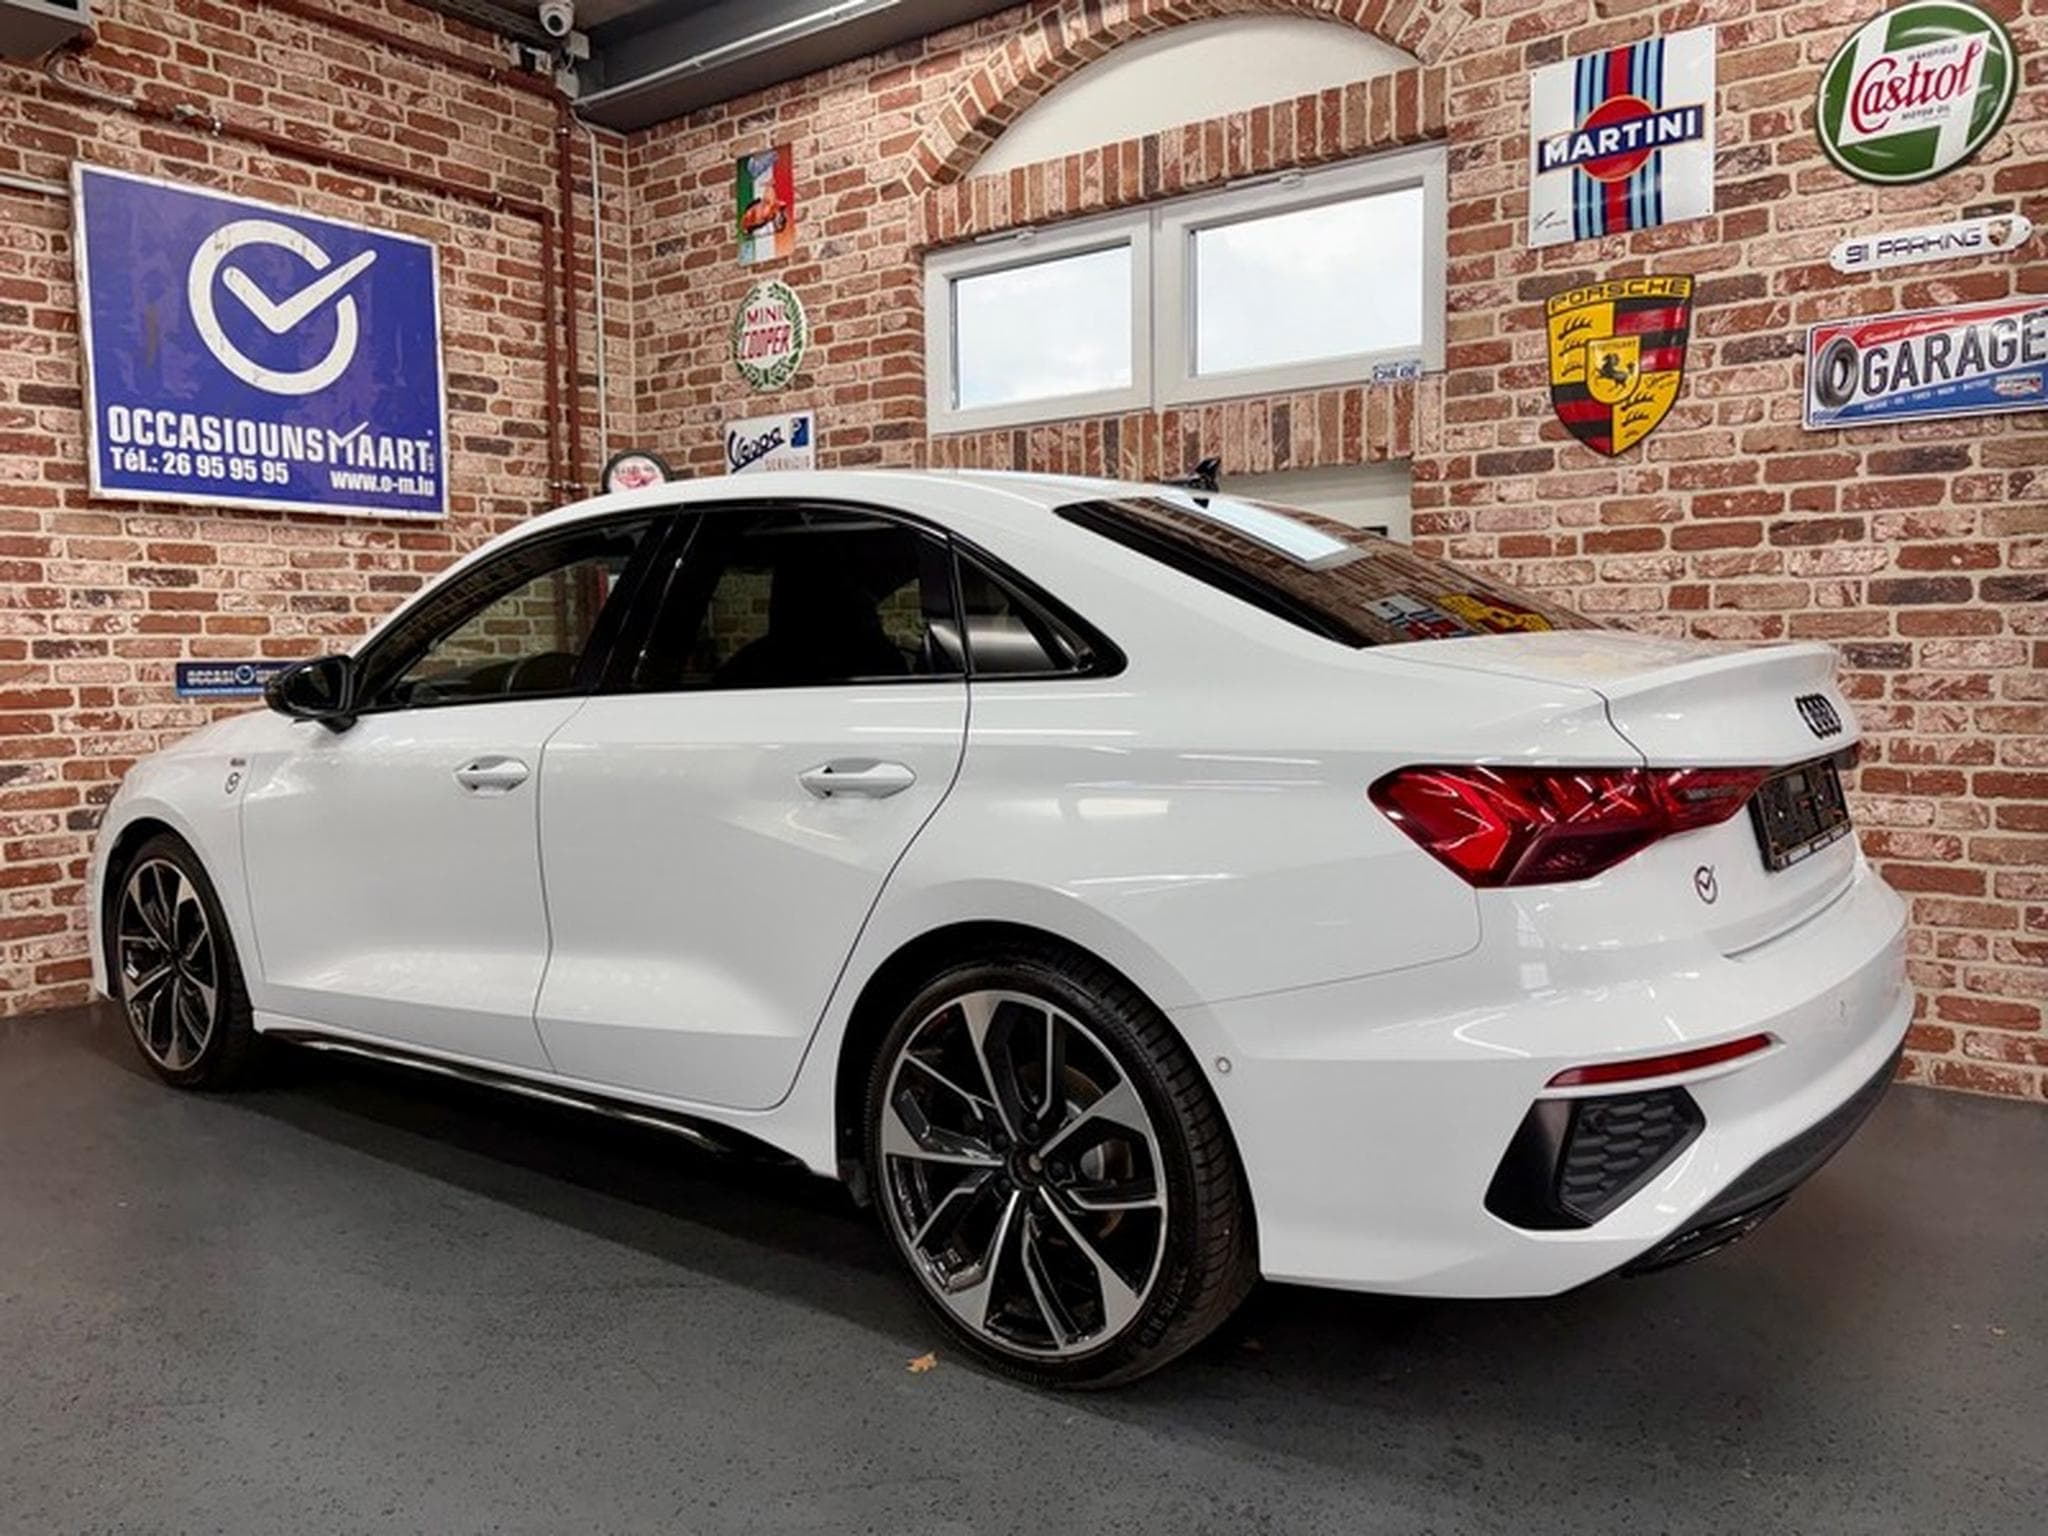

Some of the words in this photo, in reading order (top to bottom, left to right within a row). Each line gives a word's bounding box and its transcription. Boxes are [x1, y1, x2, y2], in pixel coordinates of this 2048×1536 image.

[1851, 40, 1983, 134] Castrol
[1544, 109, 1695, 168] MARTINI
[1876, 227, 1982, 260] PARKING
[1551, 278, 1686, 310] PORSCHE
[747, 304, 785, 326] MINI
[740, 325, 791, 360] COOPER
[1862, 310, 2048, 398] GARAGE
[107, 405, 431, 474] OCCASIOUNSMAART
[728, 427, 785, 474] Vespa
[163, 451, 191, 476] 26
[197, 455, 225, 479] 95
[230, 458, 257, 482] 95
[262, 461, 290, 485] 95
[330, 470, 435, 497] www.o-m.lu
